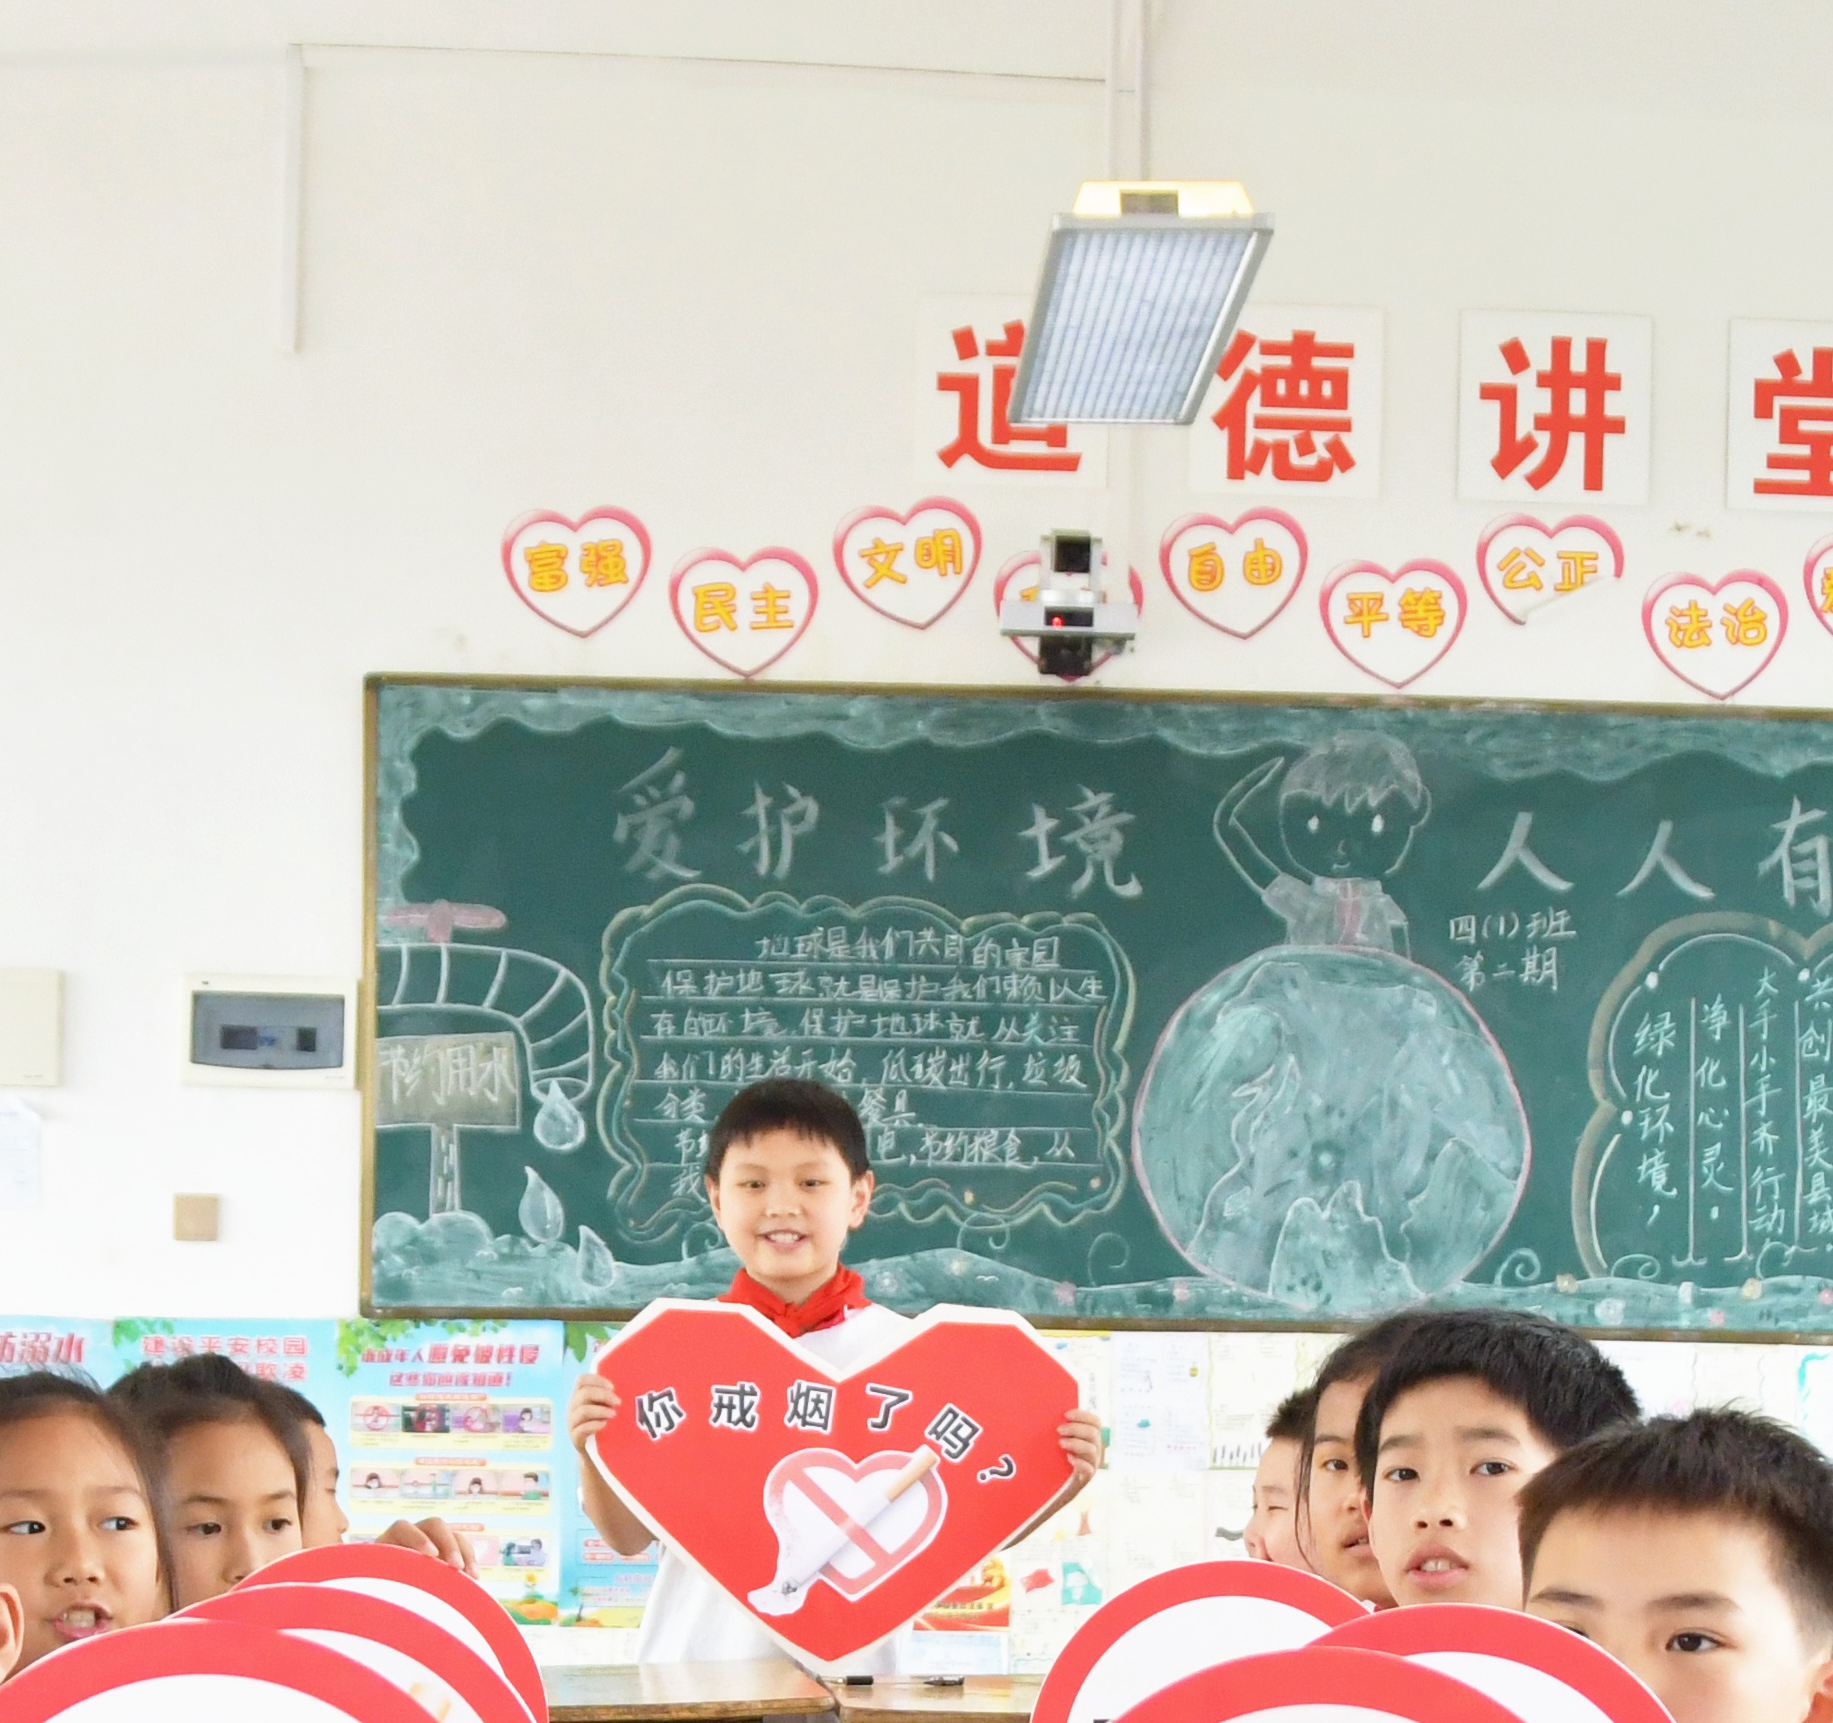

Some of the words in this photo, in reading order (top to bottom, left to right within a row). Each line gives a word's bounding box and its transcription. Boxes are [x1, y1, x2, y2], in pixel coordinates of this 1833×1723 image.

[523, 541, 630, 592] 富强
[858, 527, 964, 588] 文明
[1185, 539, 1282, 592] 自由
[1496, 545, 1600, 592] 公正
[691, 583, 795, 633] 民主
[1343, 588, 1446, 638] 平等
[1665, 595, 1769, 650] 法治
[612, 747, 1144, 897] 爱护环境
[1456, 945, 1563, 996] 第二期
[634, 1380, 1018, 1484] 你戒烟了吗?
